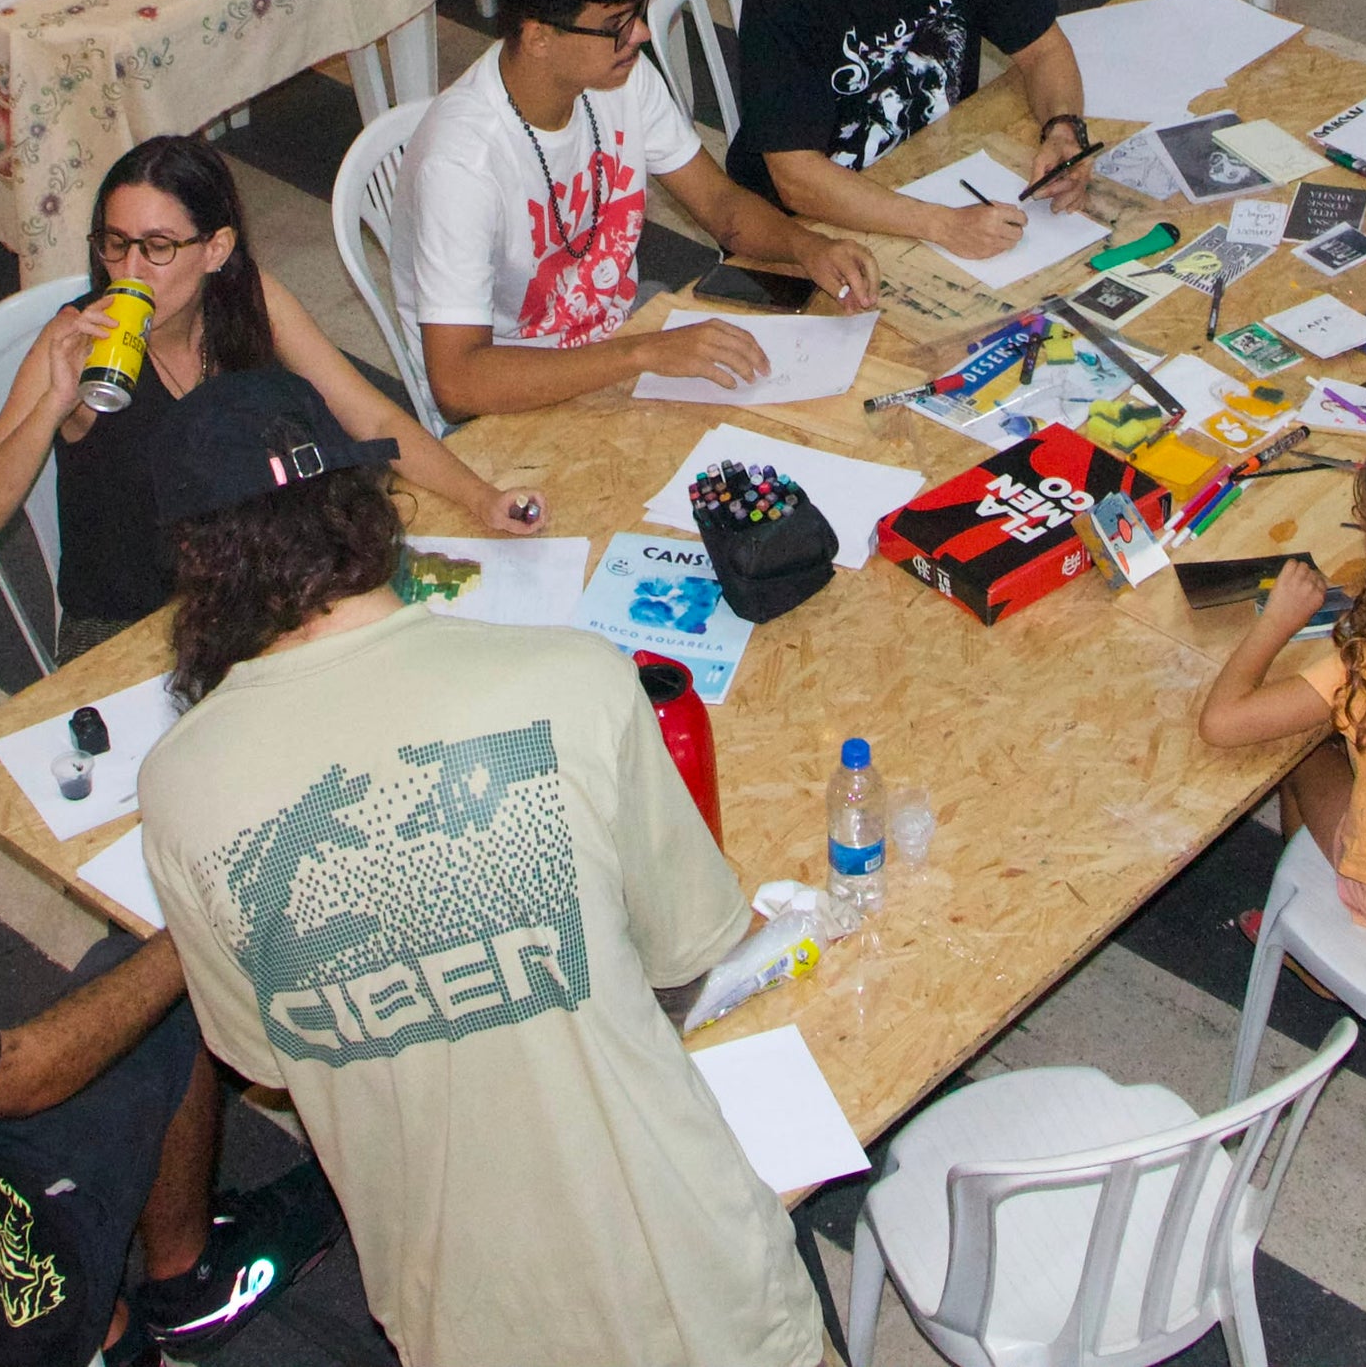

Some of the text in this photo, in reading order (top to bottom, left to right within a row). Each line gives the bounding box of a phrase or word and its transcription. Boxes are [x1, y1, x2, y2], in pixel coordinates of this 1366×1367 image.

[986, 473, 1074, 531] MEN
[1039, 477, 1095, 512] GO
[976, 494, 1048, 544] FLA
[589, 620, 723, 652] BLOCO AQUARELA
